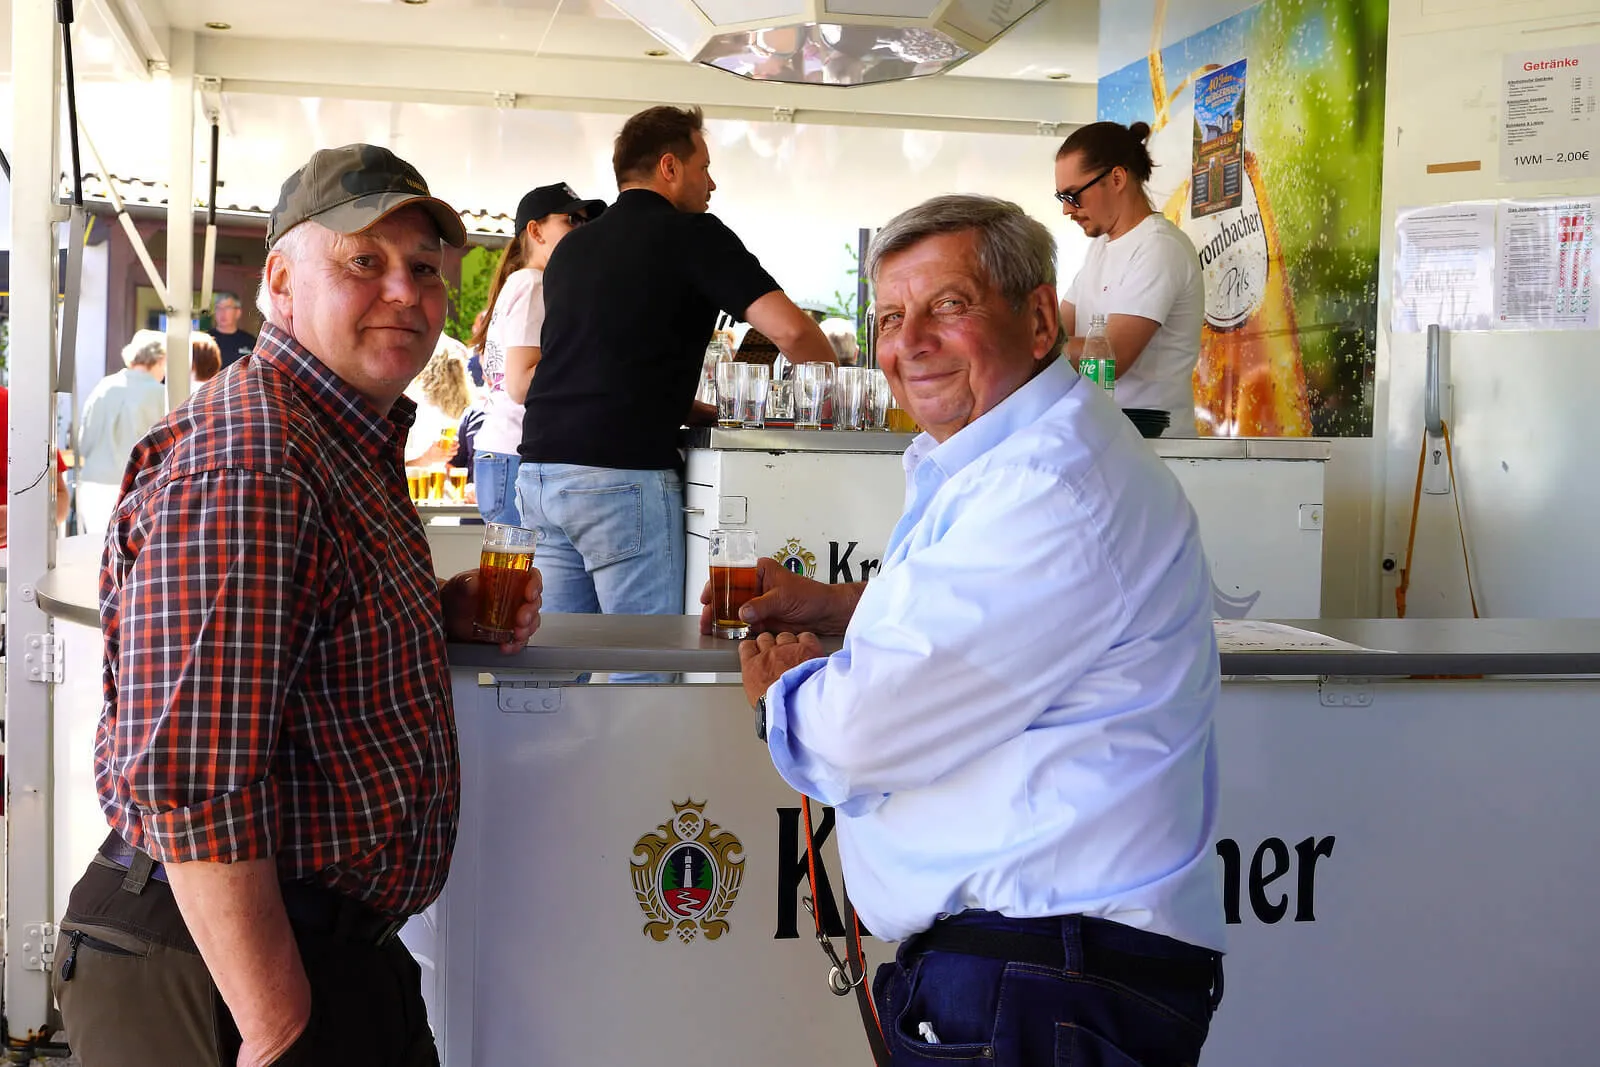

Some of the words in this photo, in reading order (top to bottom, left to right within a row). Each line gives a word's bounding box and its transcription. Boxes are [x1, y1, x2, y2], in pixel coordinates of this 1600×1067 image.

[1523, 58, 1579, 72] Getränke
[1514, 154, 1542, 166] 1WM
[1556, 150, 1590, 163] 2,00€
[1198, 208, 1260, 271] rombacher
[1217, 267, 1250, 309] Pils
[1079, 361, 1097, 375] ite
[829, 541, 883, 585] Kr
